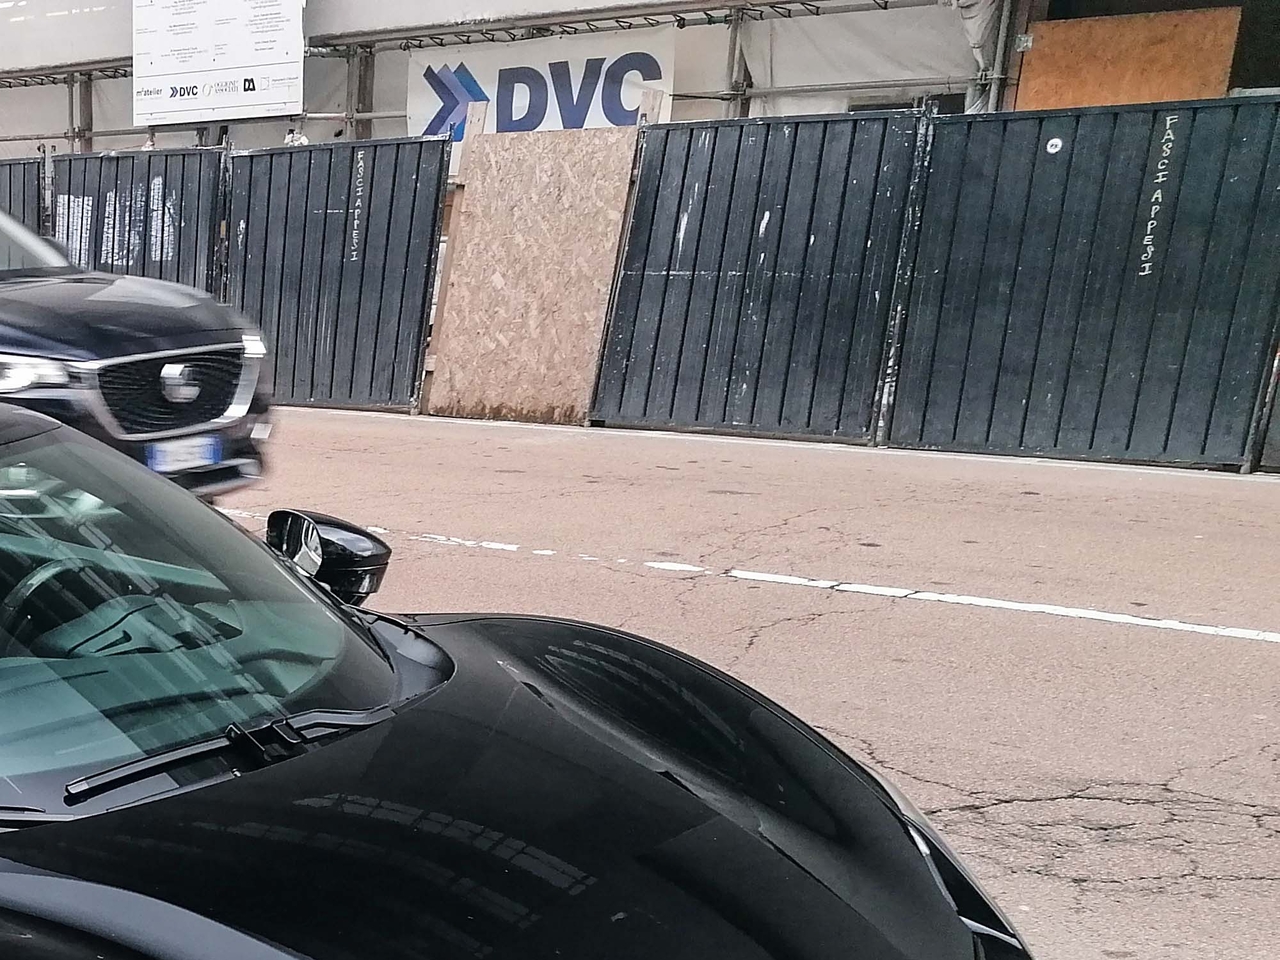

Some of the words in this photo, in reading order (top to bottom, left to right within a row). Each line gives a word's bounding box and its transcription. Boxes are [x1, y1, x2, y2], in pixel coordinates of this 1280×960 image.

[179, 85, 198, 97] DVC
[496, 51, 662, 133] DVC
[355, 150, 365, 196] FASCI
[1153, 115, 1178, 184] FASCI
[350, 198, 362, 261] APPESI
[1138, 189, 1162, 277] APPESI
